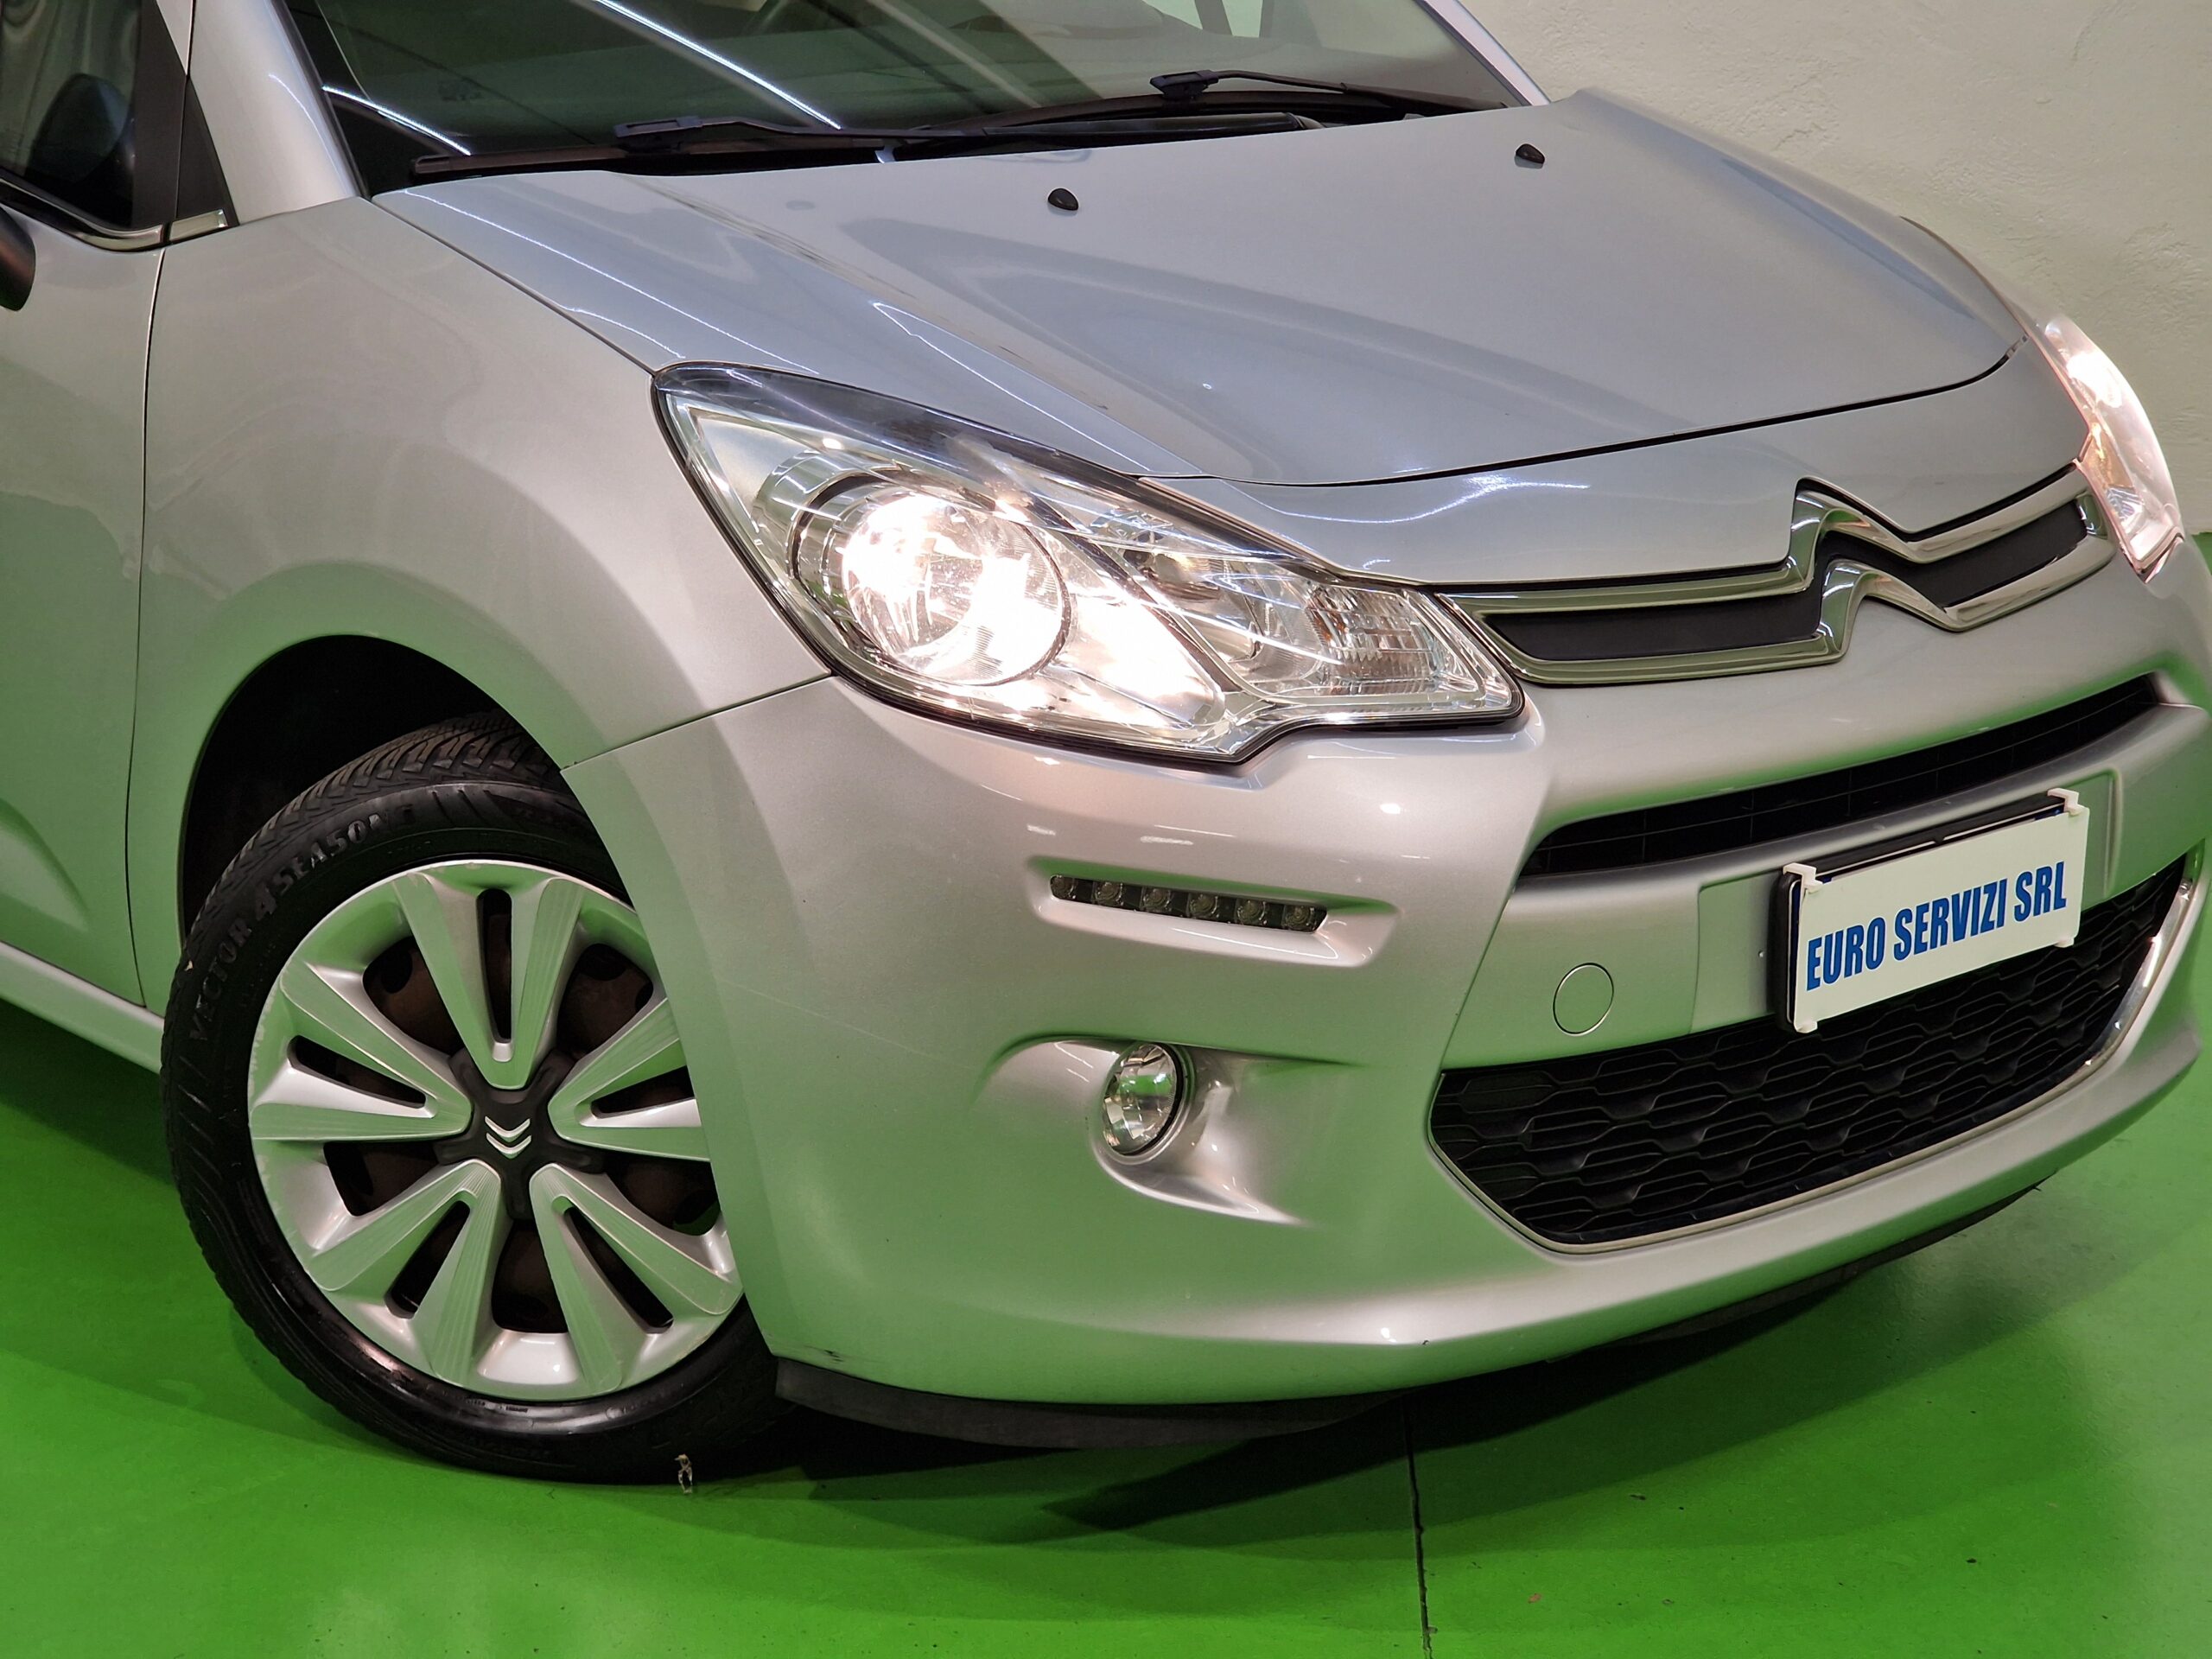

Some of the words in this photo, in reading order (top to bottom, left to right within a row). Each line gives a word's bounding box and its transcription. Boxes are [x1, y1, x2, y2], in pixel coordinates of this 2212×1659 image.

[1806, 918, 1885, 991] EURO
[1893, 878, 2007, 961] SERVIZI
[2013, 861, 2067, 922] SRL
